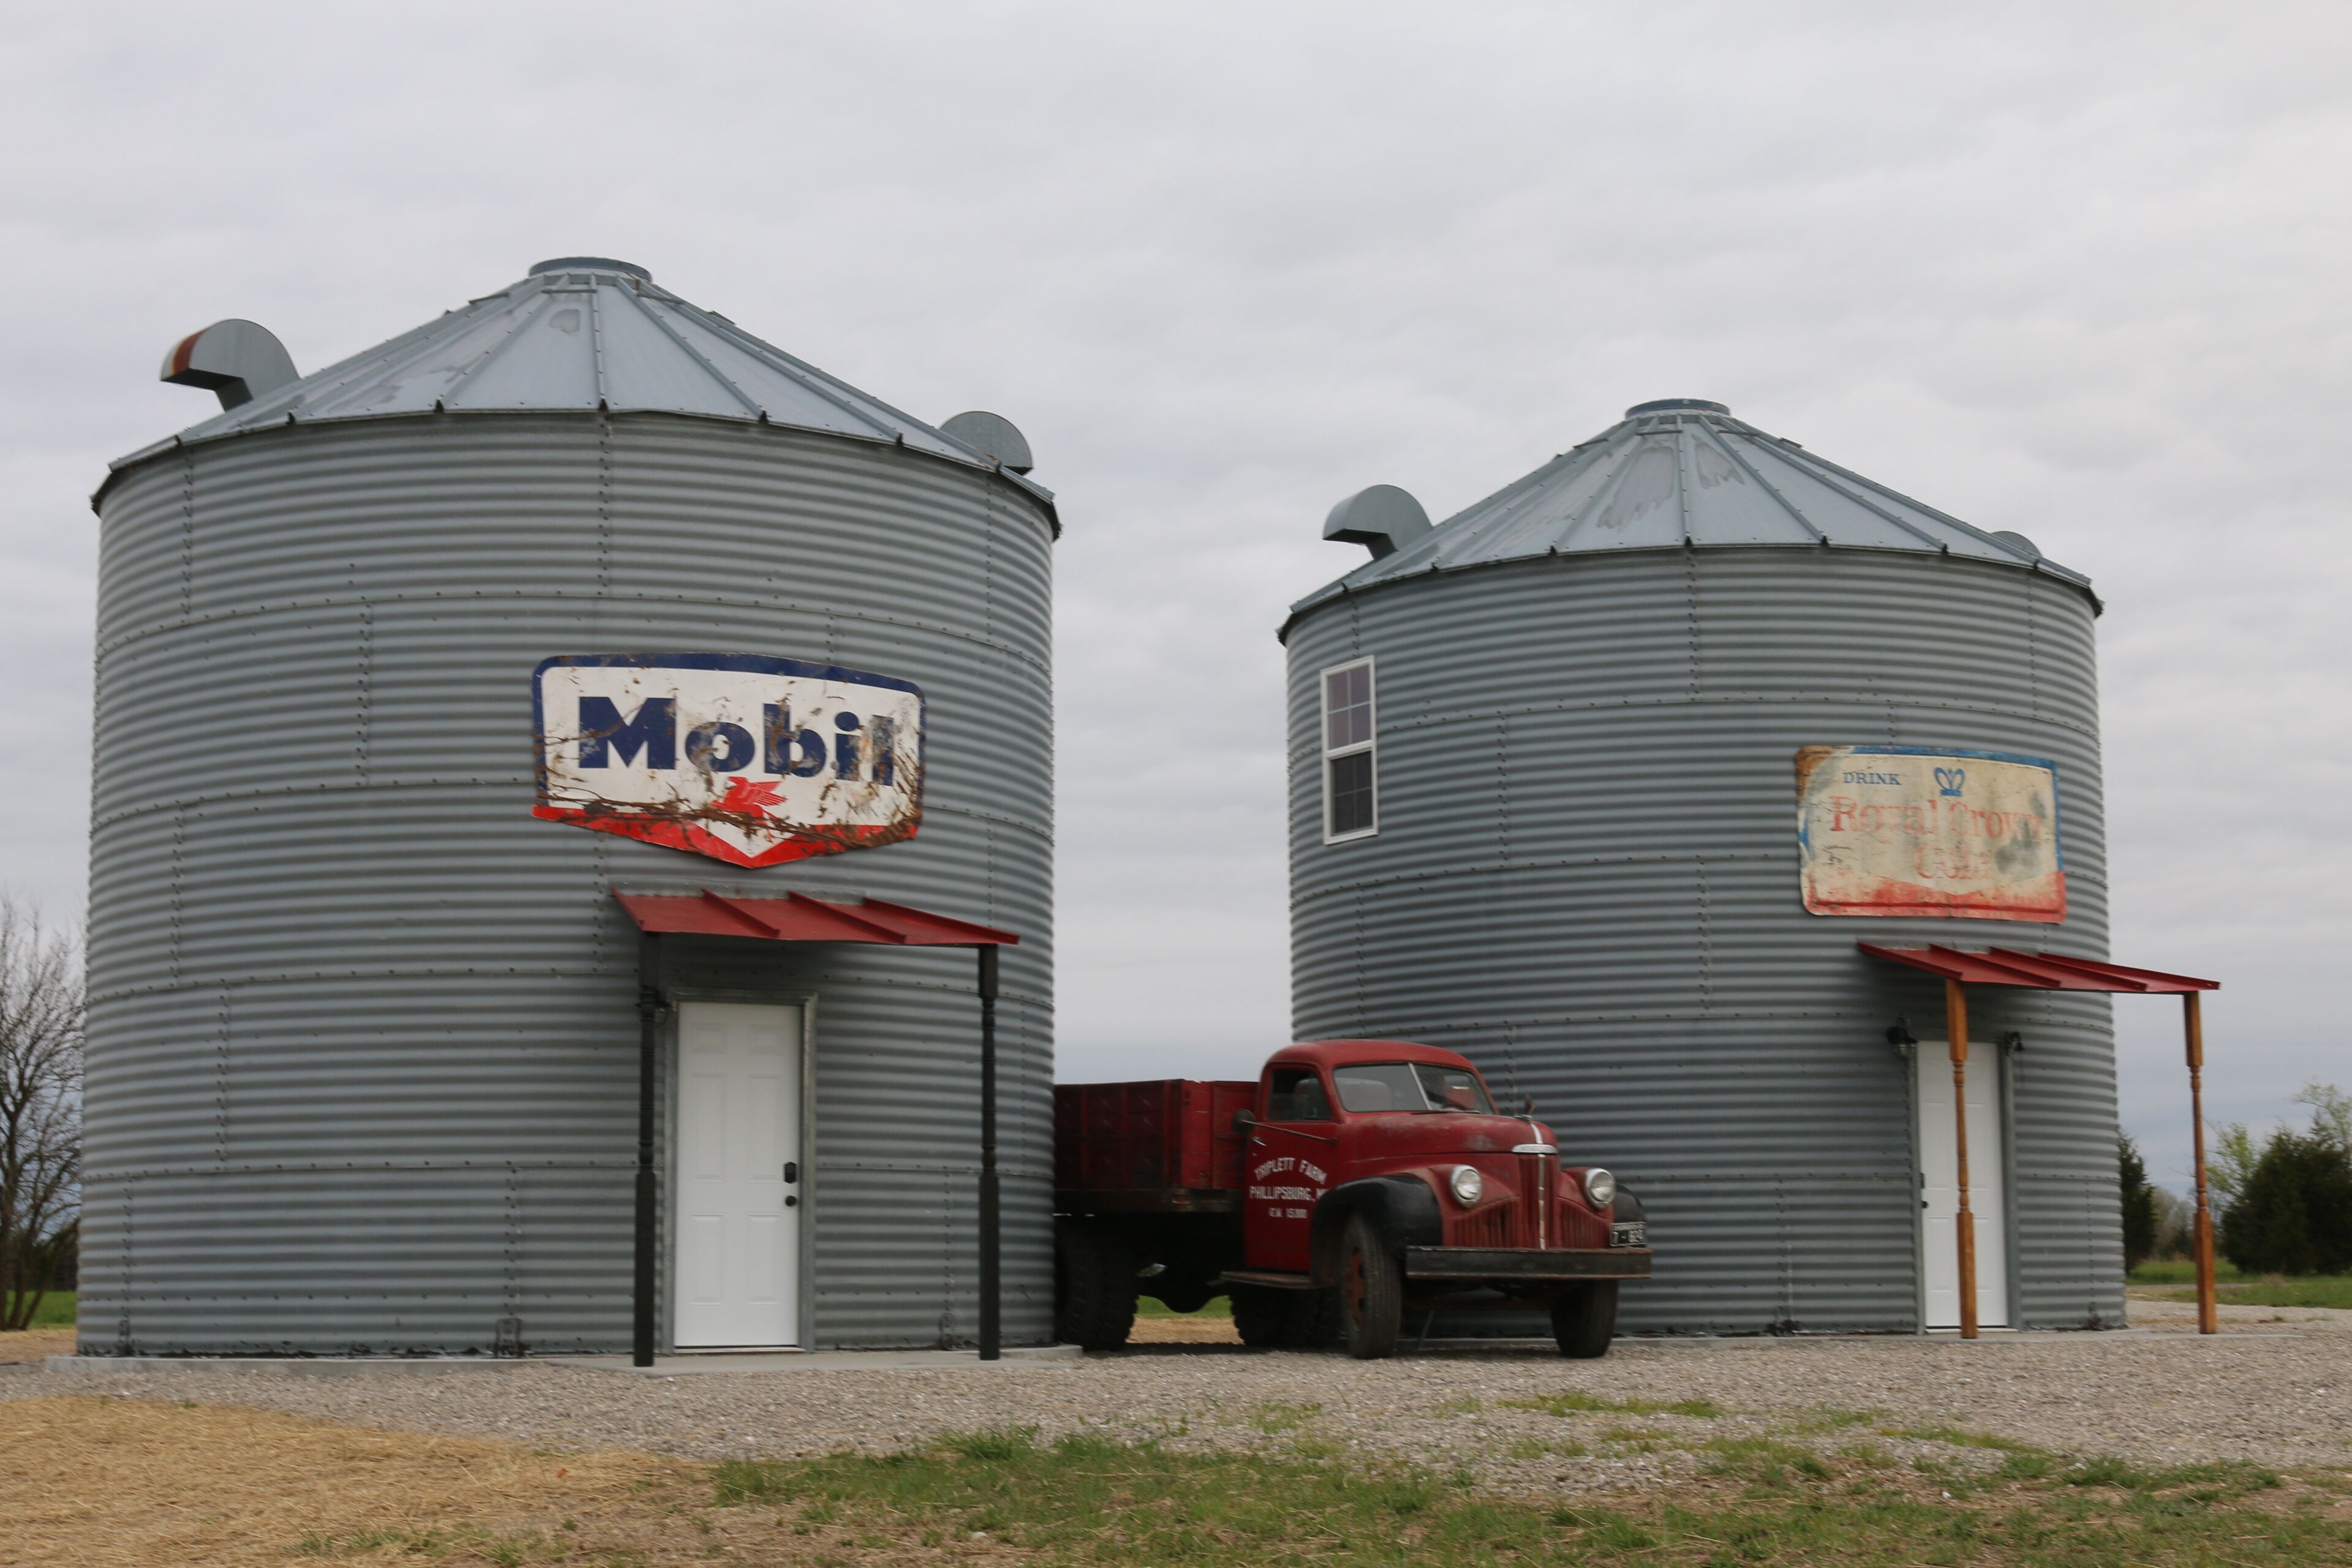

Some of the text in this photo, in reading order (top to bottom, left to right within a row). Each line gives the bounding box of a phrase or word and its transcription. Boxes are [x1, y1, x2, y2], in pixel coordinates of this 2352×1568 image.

[579, 696, 894, 786] Mobil
[1842, 772, 1902, 786] DRINK
[1254, 1157, 1327, 1185] TRIPLETT FARM
[1316, 1187, 1329, 1200] M
